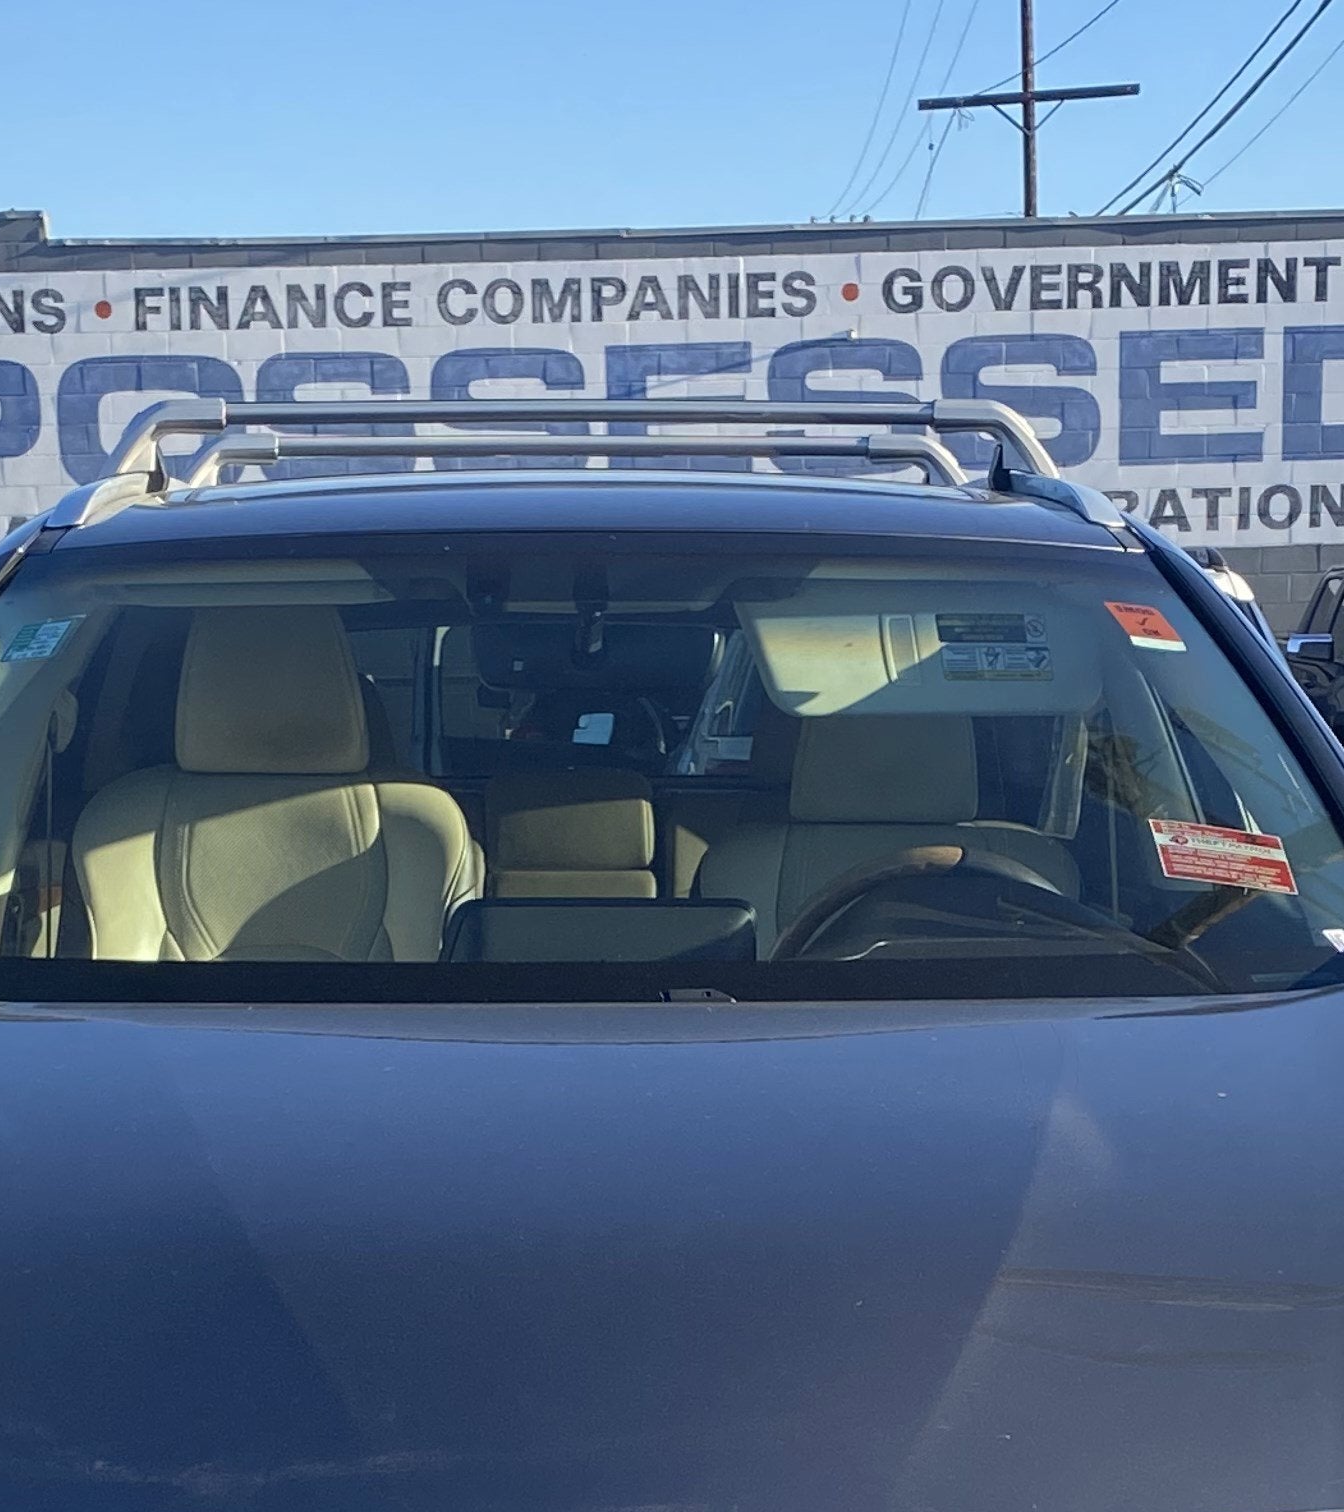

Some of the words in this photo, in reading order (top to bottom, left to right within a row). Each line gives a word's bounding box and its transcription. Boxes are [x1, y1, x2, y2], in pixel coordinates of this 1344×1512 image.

[134, 281, 413, 332] FINANCE
[438, 270, 817, 325] COMPANIES
[882, 256, 1341, 314] GOVERNMENT
